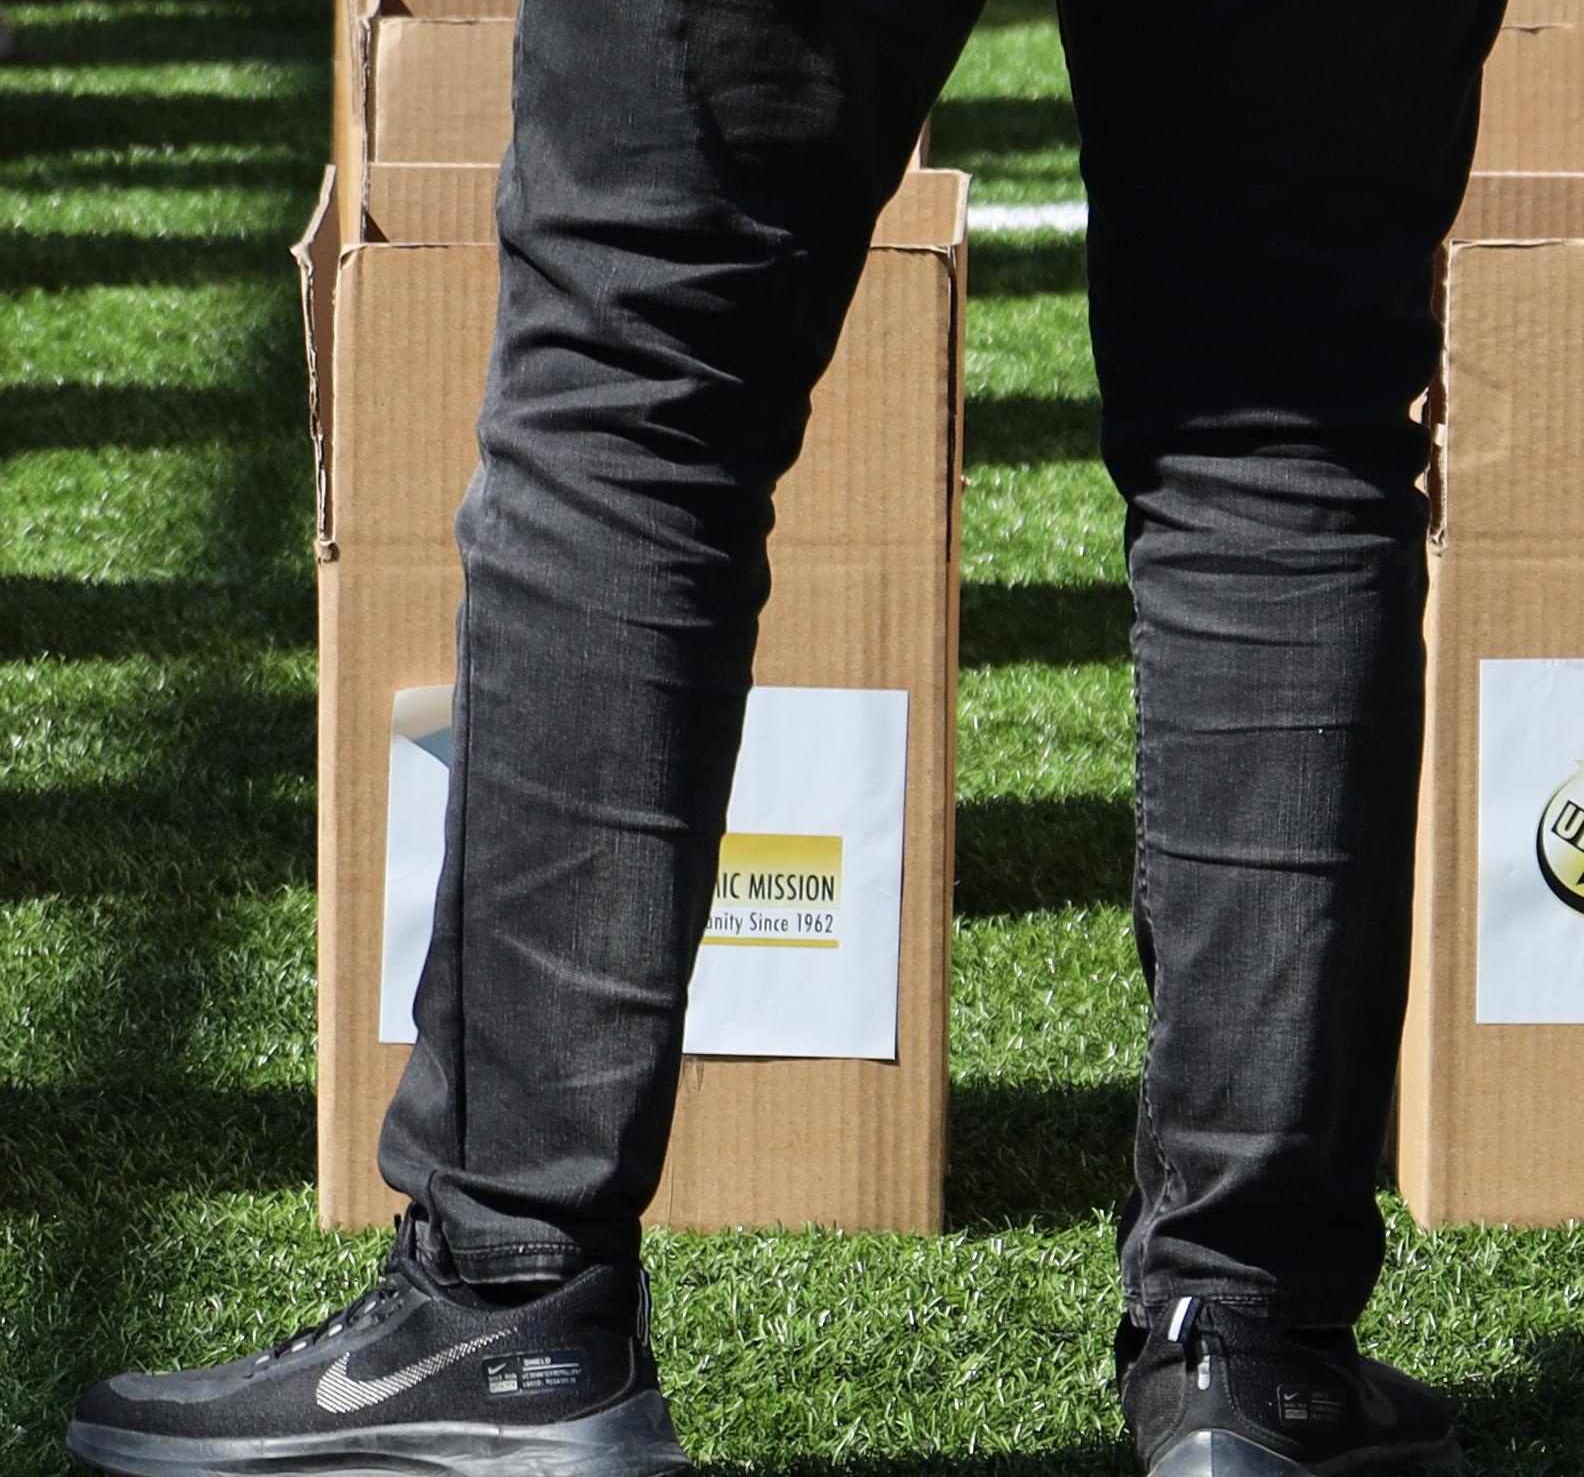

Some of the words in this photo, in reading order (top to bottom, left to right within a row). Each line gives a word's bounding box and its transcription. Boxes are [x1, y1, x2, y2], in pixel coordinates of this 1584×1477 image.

[748, 873, 834, 902] MISSION
[706, 911, 743, 935] anity
[749, 911, 788, 933] Since
[797, 912, 833, 934] 1962
